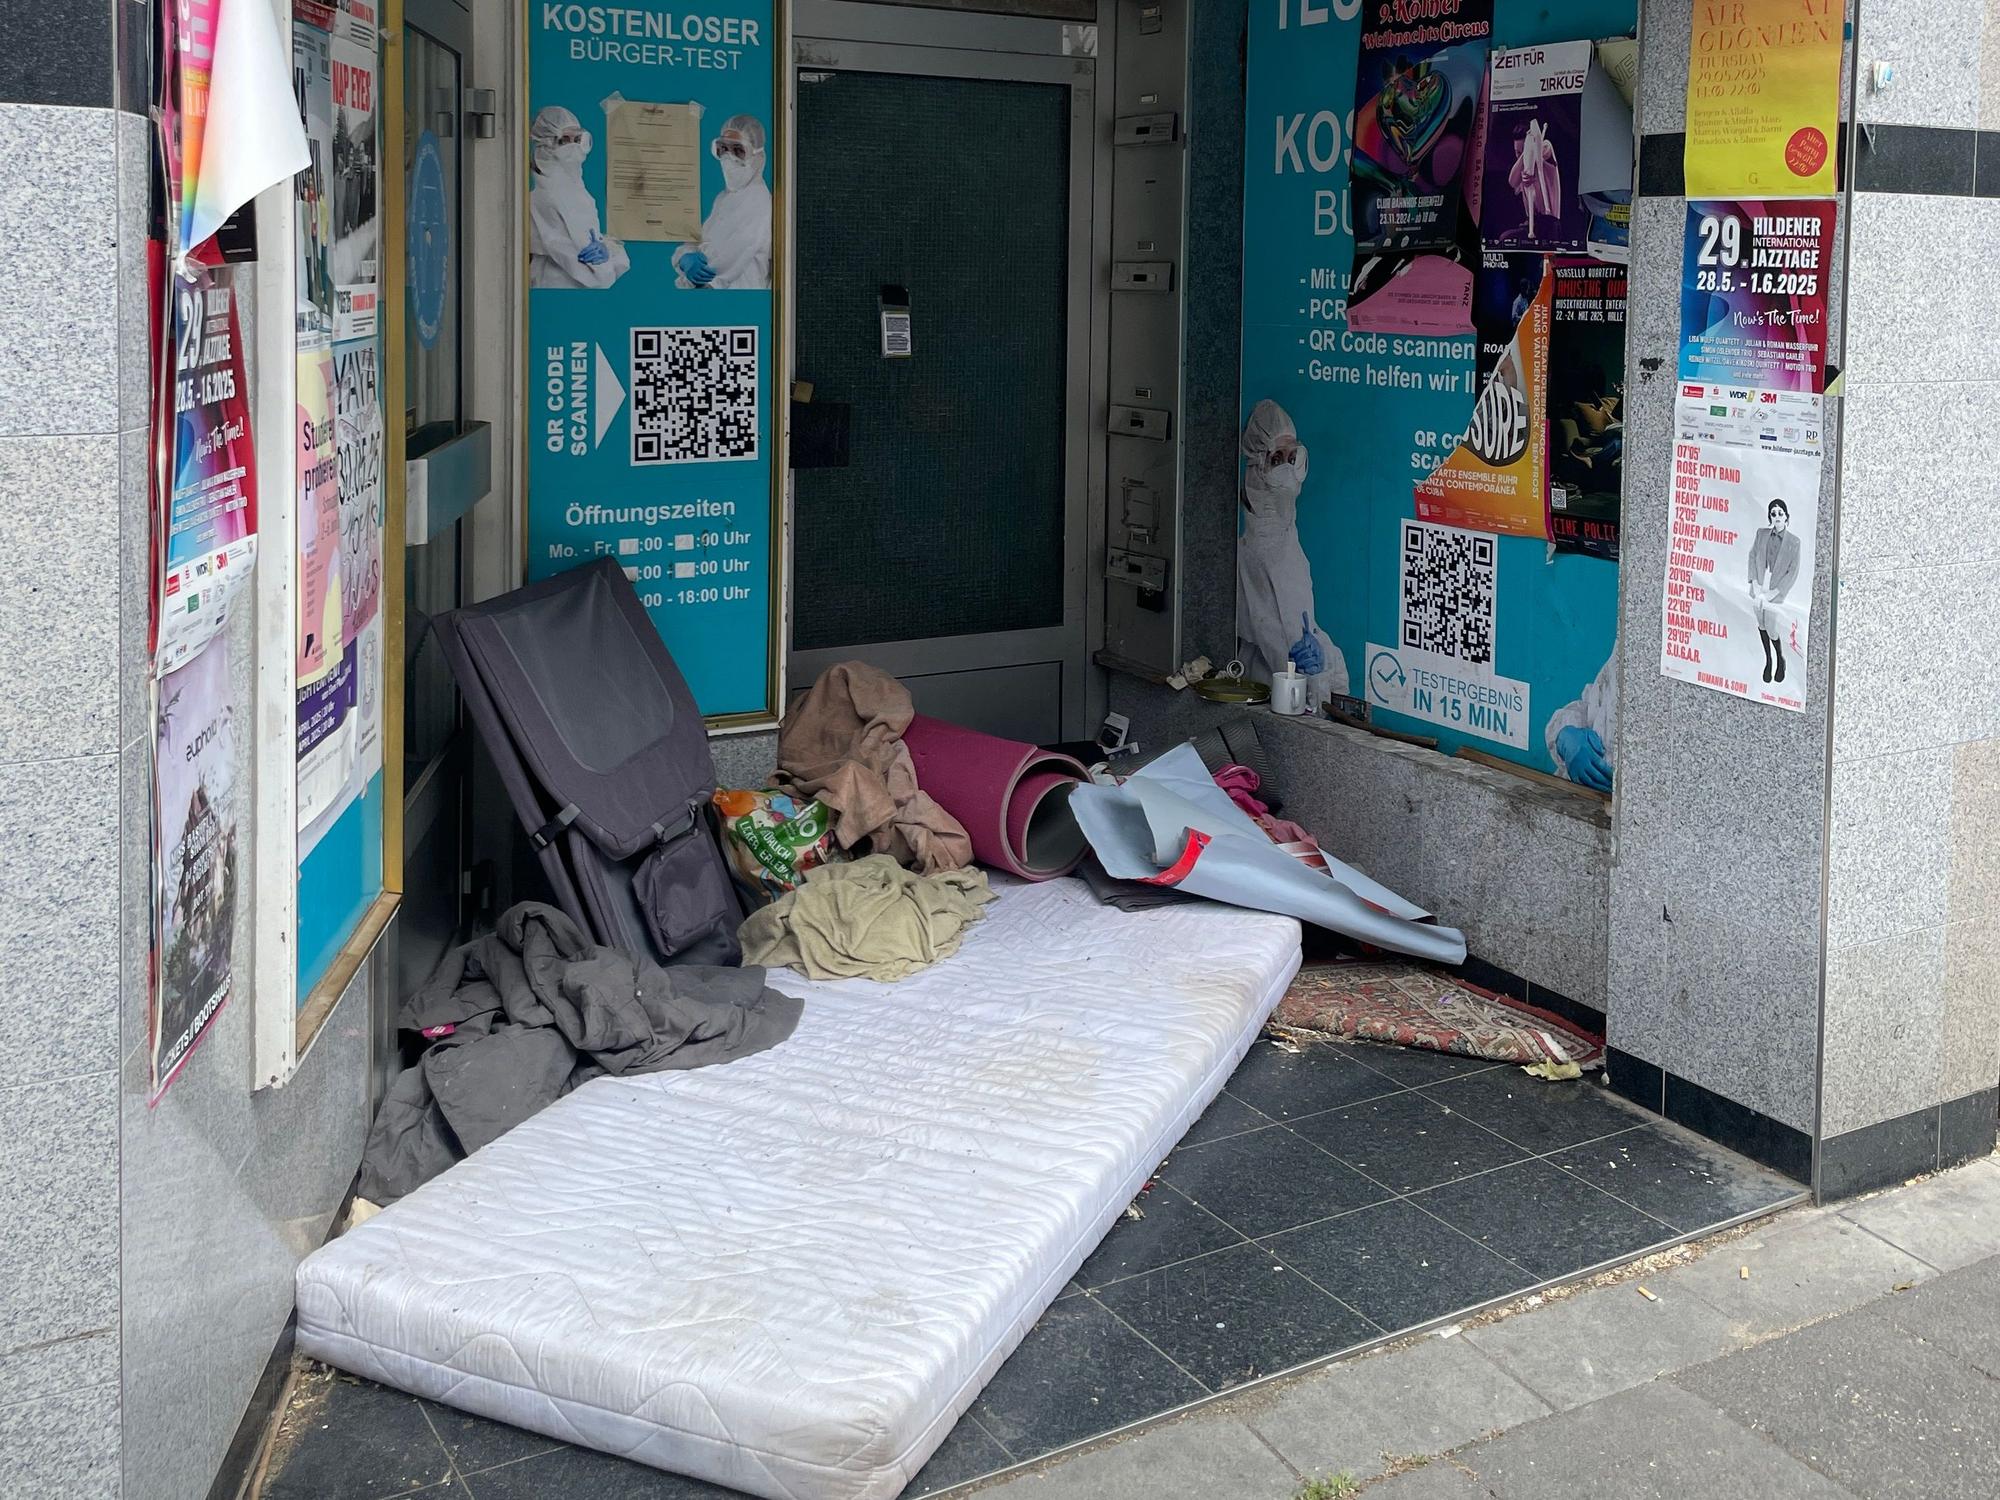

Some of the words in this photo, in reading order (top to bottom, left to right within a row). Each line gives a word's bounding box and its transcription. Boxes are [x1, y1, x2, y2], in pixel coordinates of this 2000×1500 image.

[543, 3, 760, 46] KOSTENLOSER
[570, 37, 743, 71] BÜRGER-TEST
[1495, 54, 1522, 69] ZEIT
[1524, 48, 1545, 66] FÜR
[333, 60, 349, 106] NAP
[351, 66, 371, 112] EYES
[1540, 75, 1584, 91] ZIRKUS
[1753, 217, 1821, 237] HILDENER
[1698, 215, 1749, 268] 29.
[1752, 237, 1820, 249] INTERNATIONAL
[1751, 249, 1819, 269] JAZZTAGE
[1311, 268, 1336, 289] Mit
[1588, 268, 1616, 279] QUARTETT
[1696, 270, 1735, 292] 28.5.
[1751, 272, 1818, 295] 1.6.2025
[1461, 281, 1471, 308] TANZ
[1310, 299, 1347, 320] PCR
[1533, 304, 1541, 334] HANS
[1734, 311, 1764, 327] Now's
[1767, 308, 1786, 325] The
[1787, 308, 1819, 325] Time!
[1309, 329, 1335, 351] QR
[1341, 331, 1387, 355] Code
[1393, 337, 1475, 360] scannen
[1483, 343, 1505, 354] ROA
[546, 345, 564, 411] CODE
[1309, 360, 1360, 384] Gerne
[1366, 364, 1422, 389] helfen
[1428, 369, 1459, 392] wir
[570, 341, 588, 456] SCANNEN
[1729, 391, 1747, 400] WDR
[1760, 393, 1777, 404] 3M
[1532, 385, 1540, 428] BROECK
[1462, 382, 1527, 460] SURE
[546, 418, 564, 452] QR
[1414, 431, 1437, 448] QR
[1806, 431, 1818, 440] RP
[1411, 452, 1448, 470] SCA
[1677, 460, 1698, 475] ROSE
[1700, 464, 1717, 478] CITY
[1719, 467, 1741, 483] BAND
[1425, 478, 1444, 488] ANZA
[1446, 479, 1517, 495] CONTEMPORÁNEA
[1438, 469, 1457, 478] ARTS
[1458, 470, 1496, 482] ENSEMBLE
[1498, 474, 1518, 485] RUHR
[1531, 466, 1539, 500] FROST
[1426, 487, 1445, 497] CUBA
[1675, 491, 1700, 507] HEAVY
[1702, 496, 1729, 513] LUNGS
[566, 500, 735, 526] Öffnungszeiten
[1583, 522, 1616, 541] POLIT
[1673, 519, 1700, 538] GÜNER
[549, 544, 578, 558] Mo.
[594, 541, 615, 555] Fr.
[723, 531, 751, 545] Uhr
[723, 559, 750, 573] Uhr
[1670, 552, 1714, 573] EUROEURO
[678, 588, 718, 604] 18:00
[723, 586, 750, 600] Uhr
[1668, 583, 1685, 598] NAP
[1686, 586, 1705, 602] EYES
[1668, 613, 1696, 630] MASHA
[1697, 618, 1728, 639] QRELLA
[1666, 643, 1701, 664] S.U.G.A.R.
[1413, 668, 1523, 712] TESTERGEBNIS
[1413, 689, 1431, 713] IN
[1440, 696, 1460, 721] 15
[1468, 703, 1514, 737] MIN.
[194, 973, 232, 1034] BOOTSHAUS
